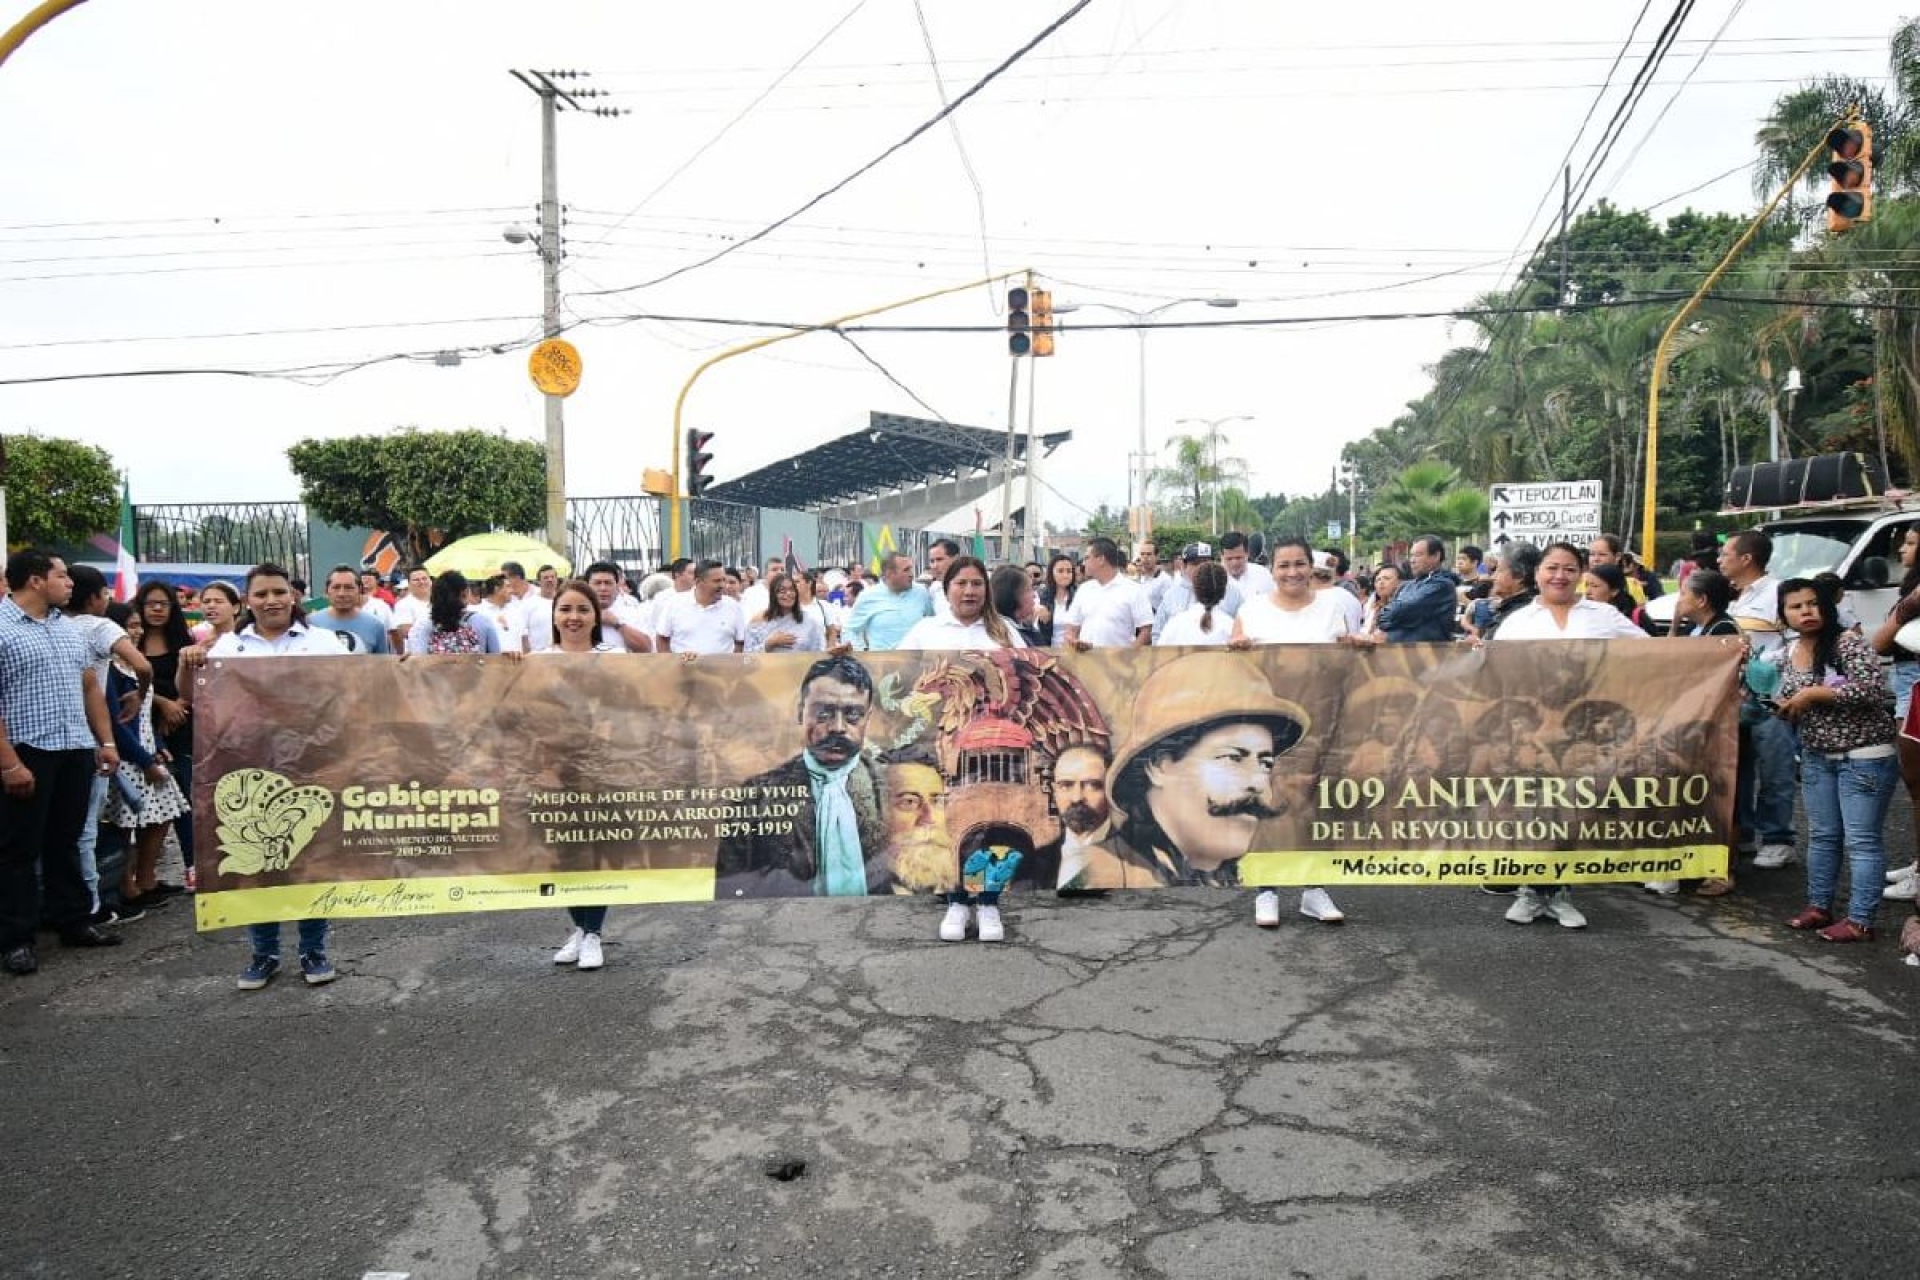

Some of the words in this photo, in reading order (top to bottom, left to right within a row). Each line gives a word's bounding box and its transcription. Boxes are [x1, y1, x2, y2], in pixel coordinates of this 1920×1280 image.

[1515, 485, 1596, 502] TEPOZTLAN
[342, 780, 500, 808] Gobierno
[597, 790, 657, 804] MORIR
[662, 789, 685, 801] DE
[721, 786, 758, 803] QUE
[762, 784, 811, 799] VIVIR
[1318, 775, 1386, 810] 109
[1393, 774, 1710, 809] ANIVERSARIO
[343, 805, 500, 833] Municipal
[528, 810, 579, 823] TODA
[583, 809, 622, 823] UNA
[624, 808, 669, 822] VIDA
[1312, 821, 1346, 841] DE
[1353, 820, 1384, 841] LA
[1391, 815, 1570, 841] REVOLUCIÓN
[1578, 815, 1714, 841] MEXICANA
[545, 828, 633, 844] EMILIANO
[640, 825, 708, 841] ZAPATA,
[714, 820, 793, 838] 1879-1919
[1438, 854, 1488, 881] país
[1493, 857, 1547, 876] libre
[1554, 861, 1569, 879] y
